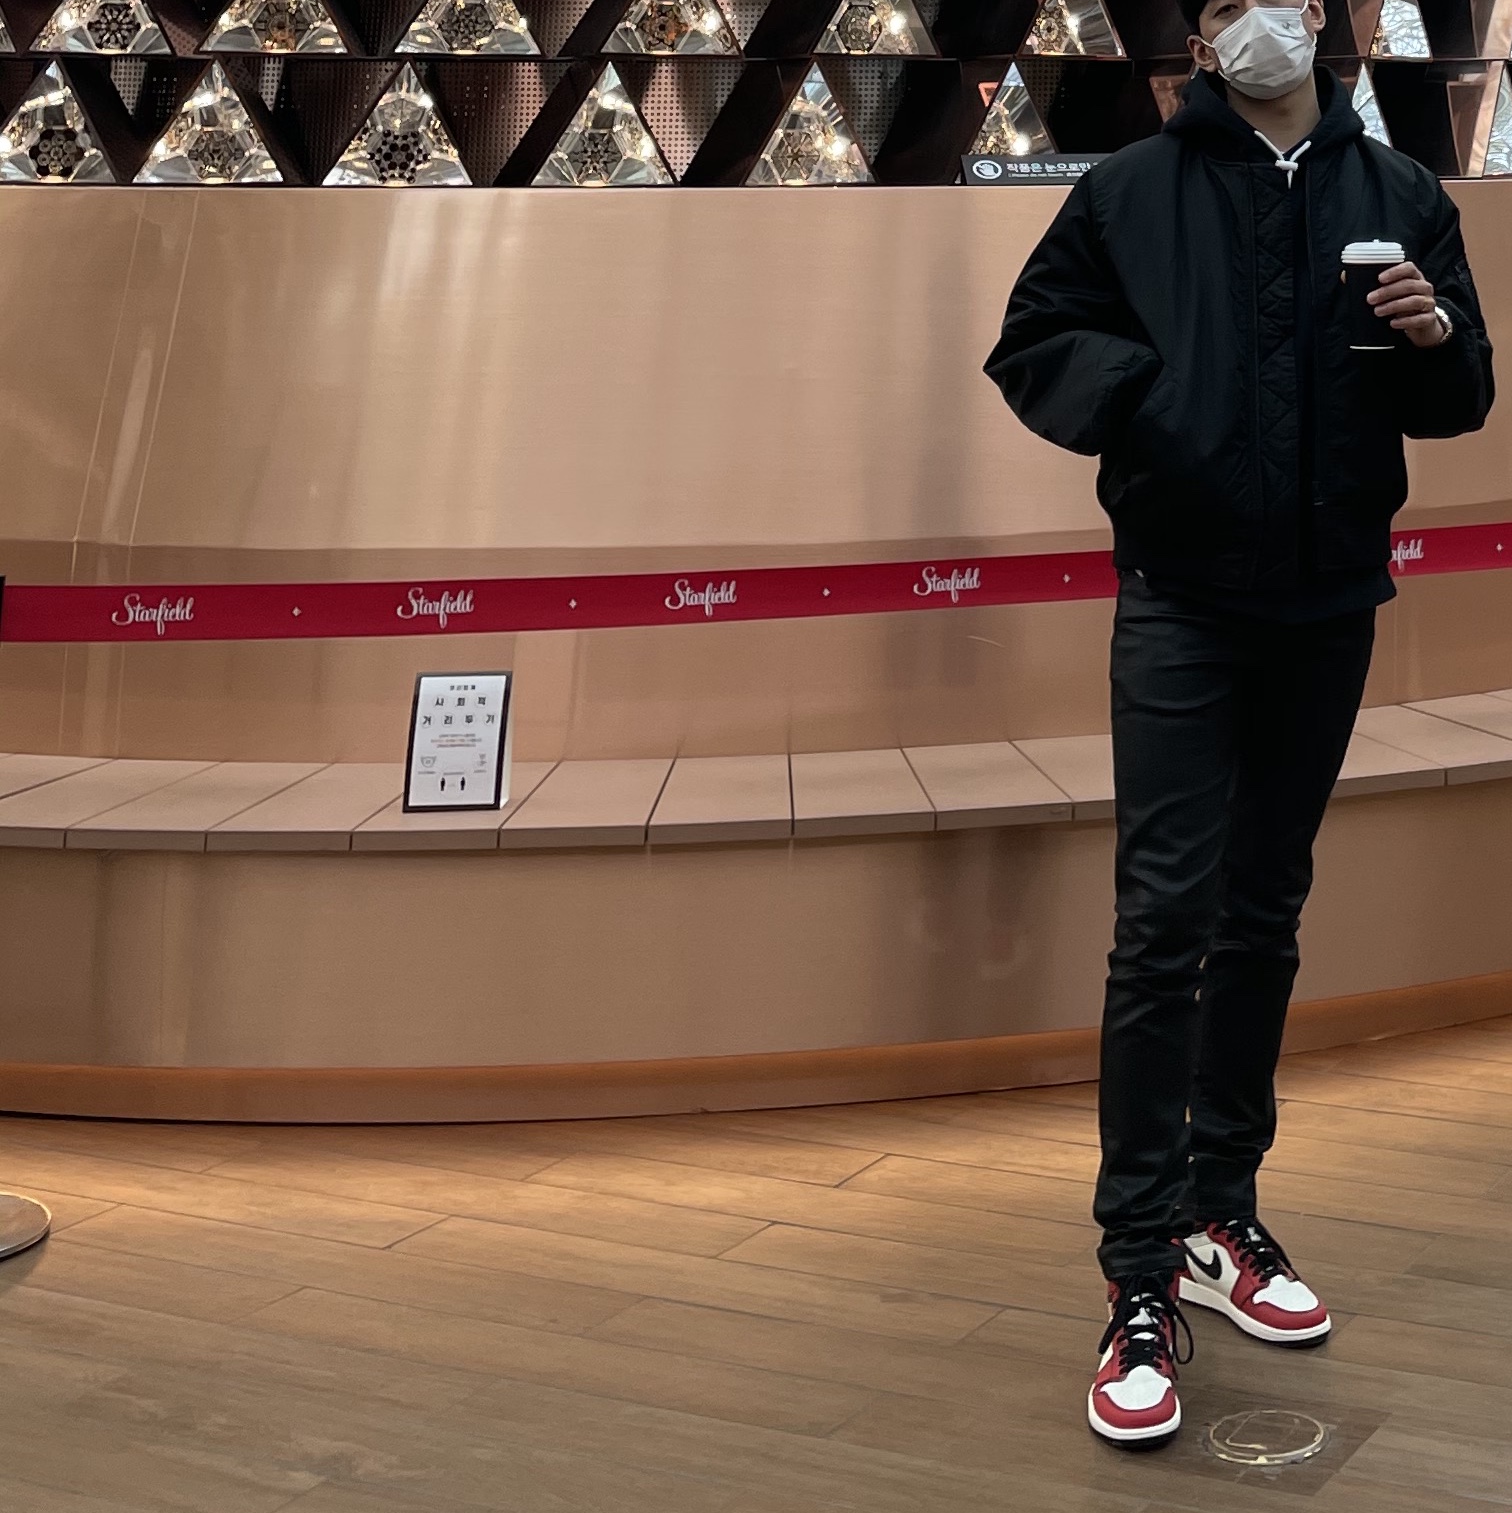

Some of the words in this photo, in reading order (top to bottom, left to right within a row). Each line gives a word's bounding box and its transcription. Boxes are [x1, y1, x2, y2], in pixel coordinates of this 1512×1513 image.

[664, 579, 737, 616] Starfield
[913, 566, 981, 603] Starfield
[111, 593, 194, 635] Starfield
[397, 587, 474, 629] Starfield
